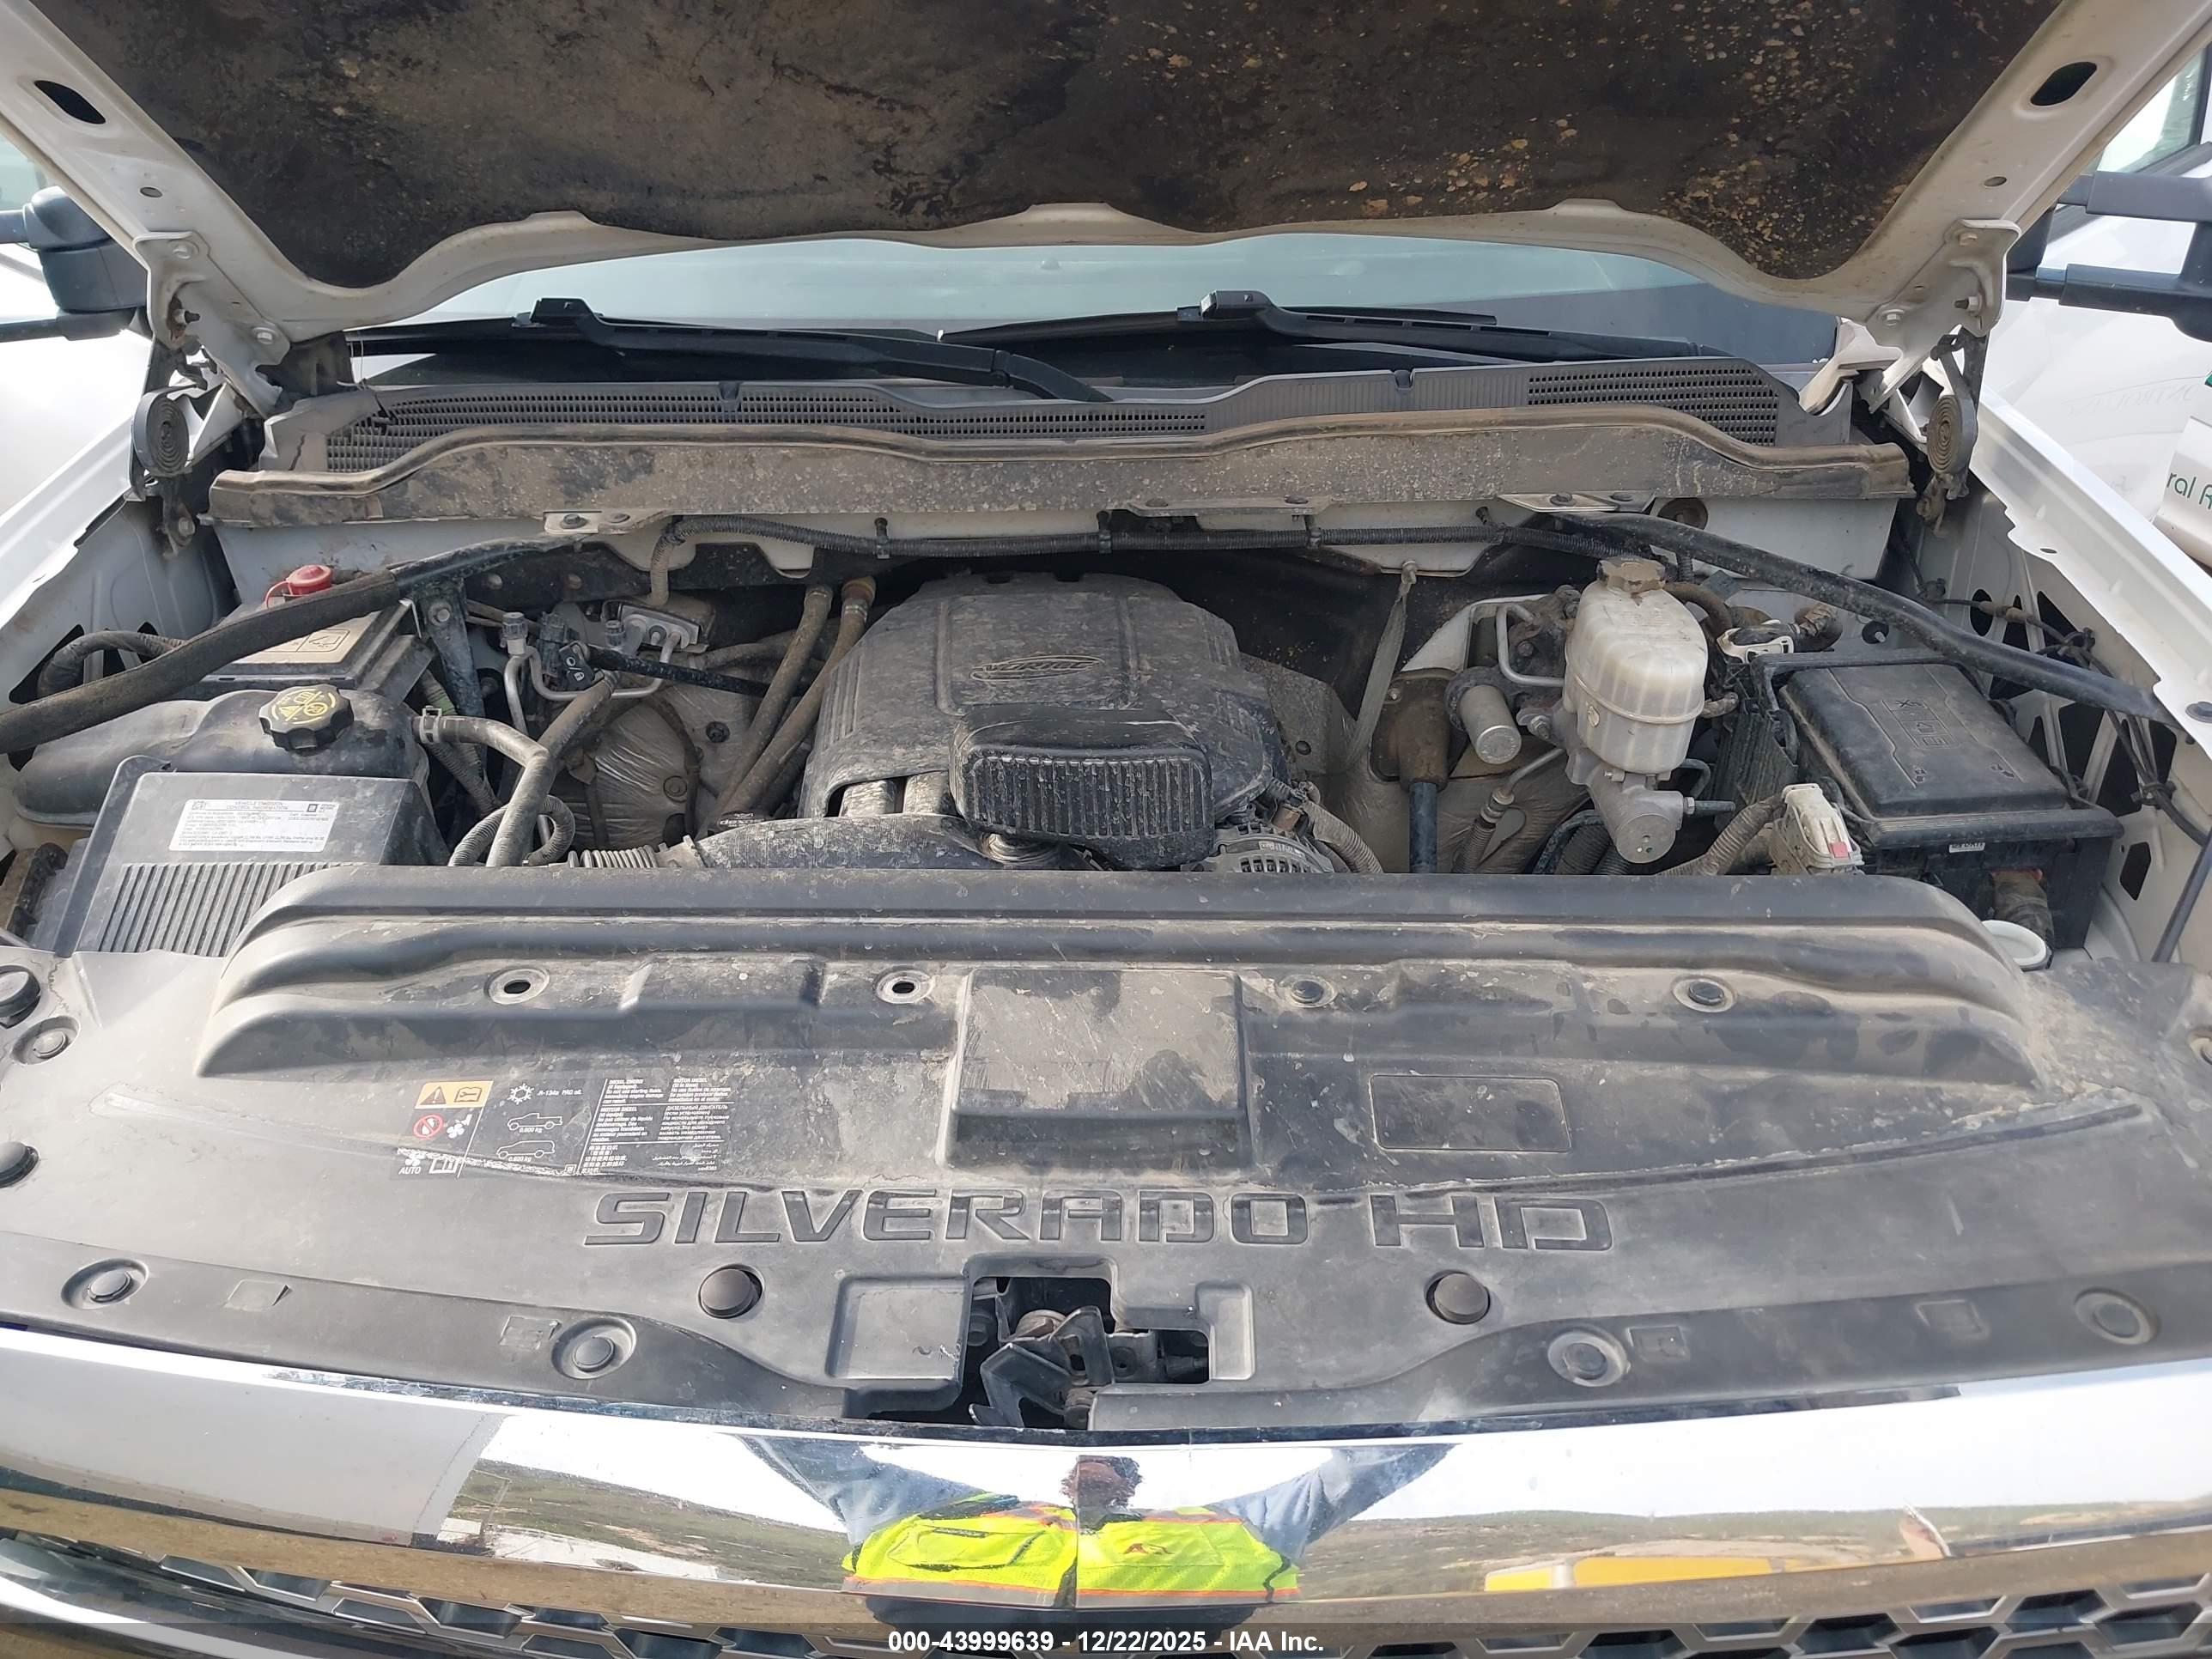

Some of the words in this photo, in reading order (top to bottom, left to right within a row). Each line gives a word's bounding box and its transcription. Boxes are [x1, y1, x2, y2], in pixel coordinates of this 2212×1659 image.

[398, 1166, 422, 1175] AUTO
[584, 1188, 1310, 1246] SILVERADO
[1369, 1194, 1613, 1251] HD
